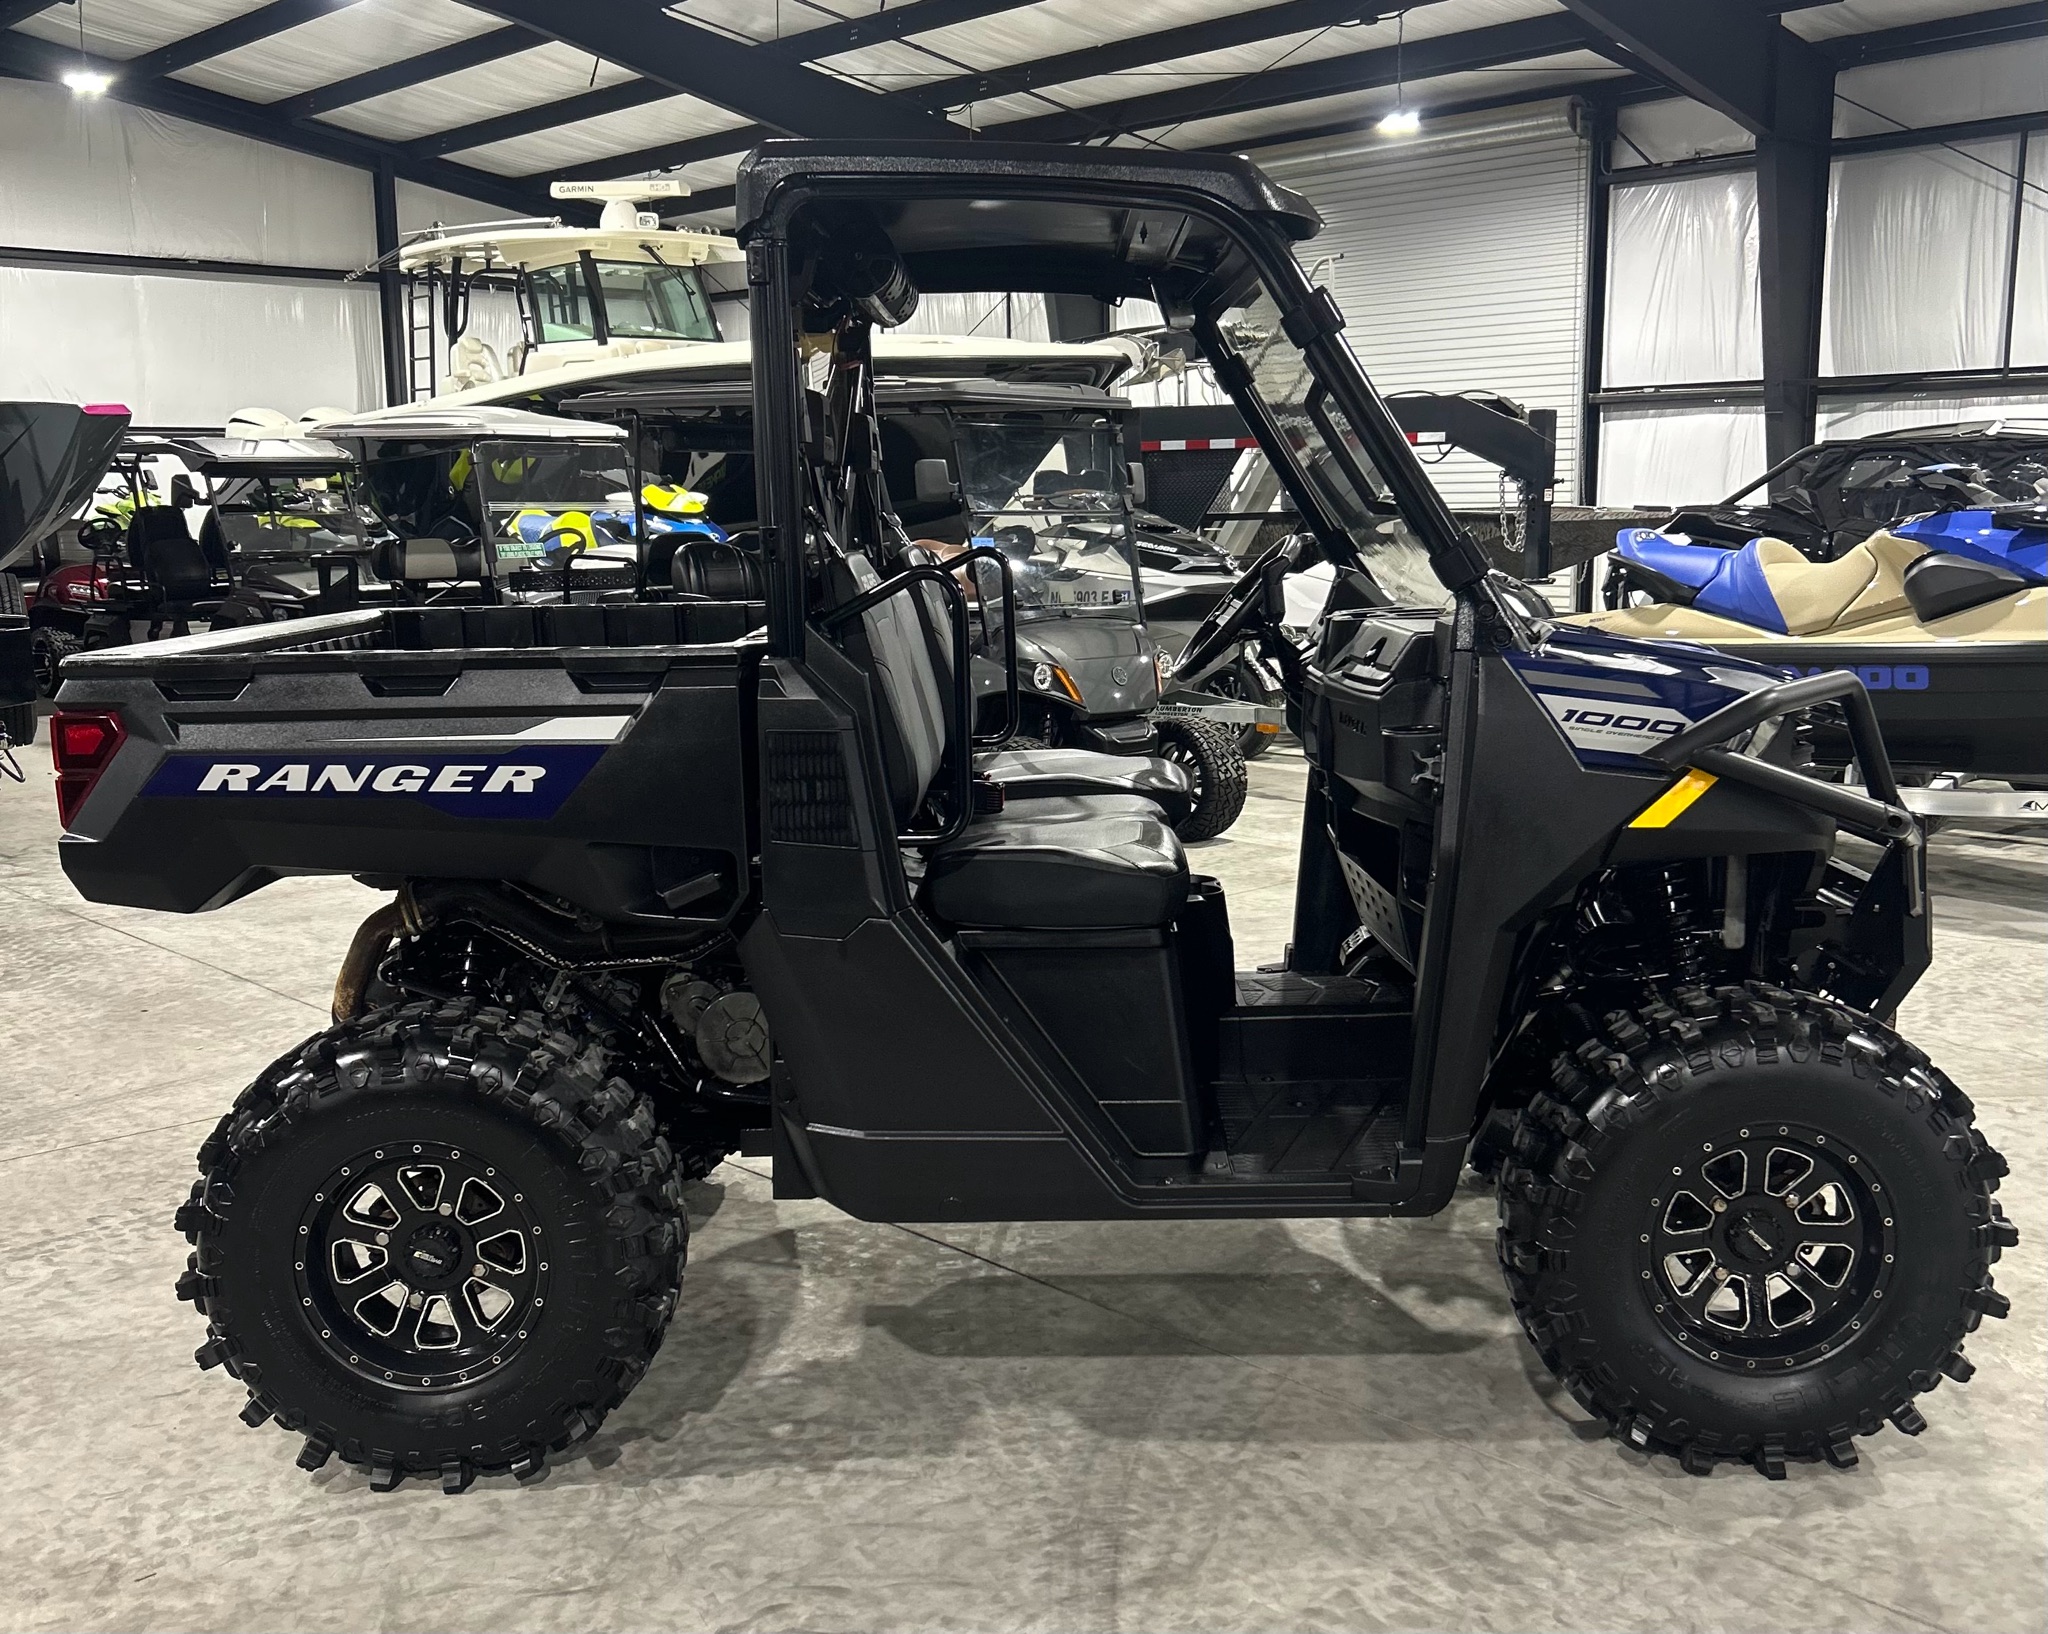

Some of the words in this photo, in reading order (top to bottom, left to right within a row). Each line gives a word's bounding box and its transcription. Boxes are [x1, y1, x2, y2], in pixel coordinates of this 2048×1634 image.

[559, 185, 594, 193] GARMIN
[1155, 705, 1203, 713] LUMBERTON
[1561, 708, 1686, 735] 1000
[1568, 725, 1603, 734] SINGLE
[1606, 730, 1655, 740] OVERHEAD
[197, 764, 546, 793] RANGER
